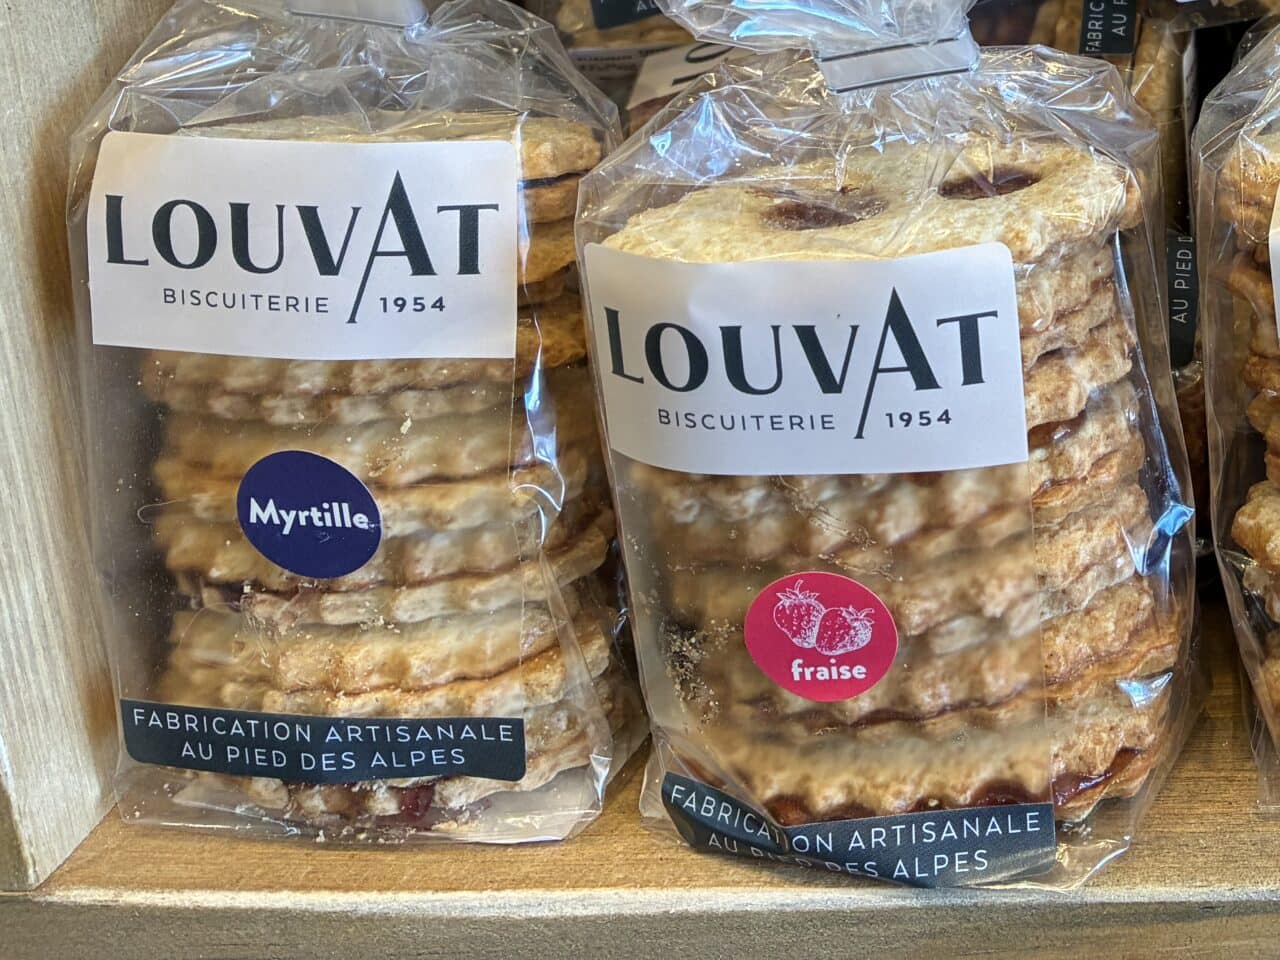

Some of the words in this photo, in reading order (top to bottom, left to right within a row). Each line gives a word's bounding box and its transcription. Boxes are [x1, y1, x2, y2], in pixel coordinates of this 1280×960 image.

[1112, 14, 1128, 36] AU
[105, 169, 499, 324] LOUVAT
[1174, 249, 1192, 289] PIED
[163, 288, 329, 314] BISCUITERIE
[379, 295, 446, 313] 1954
[1172, 299, 1189, 324] AU
[604, 286, 998, 440] LOUVAT
[658, 408, 836, 431] BISCUITERIE
[886, 408, 953, 429] 1954
[249, 497, 369, 535] Myrtille
[791, 658, 867, 681] fraise
[133, 708, 312, 742] FABRICATION
[325, 724, 514, 743] ARTISANALE
[181, 742, 213, 761] AU
[227, 748, 287, 767] PIED
[301, 751, 356, 771] DES
[370, 748, 466, 768] ALPES
[849, 812, 1042, 851] ARTISANALE
[709, 833, 738, 853] AU
[892, 849, 988, 879] ALPES
